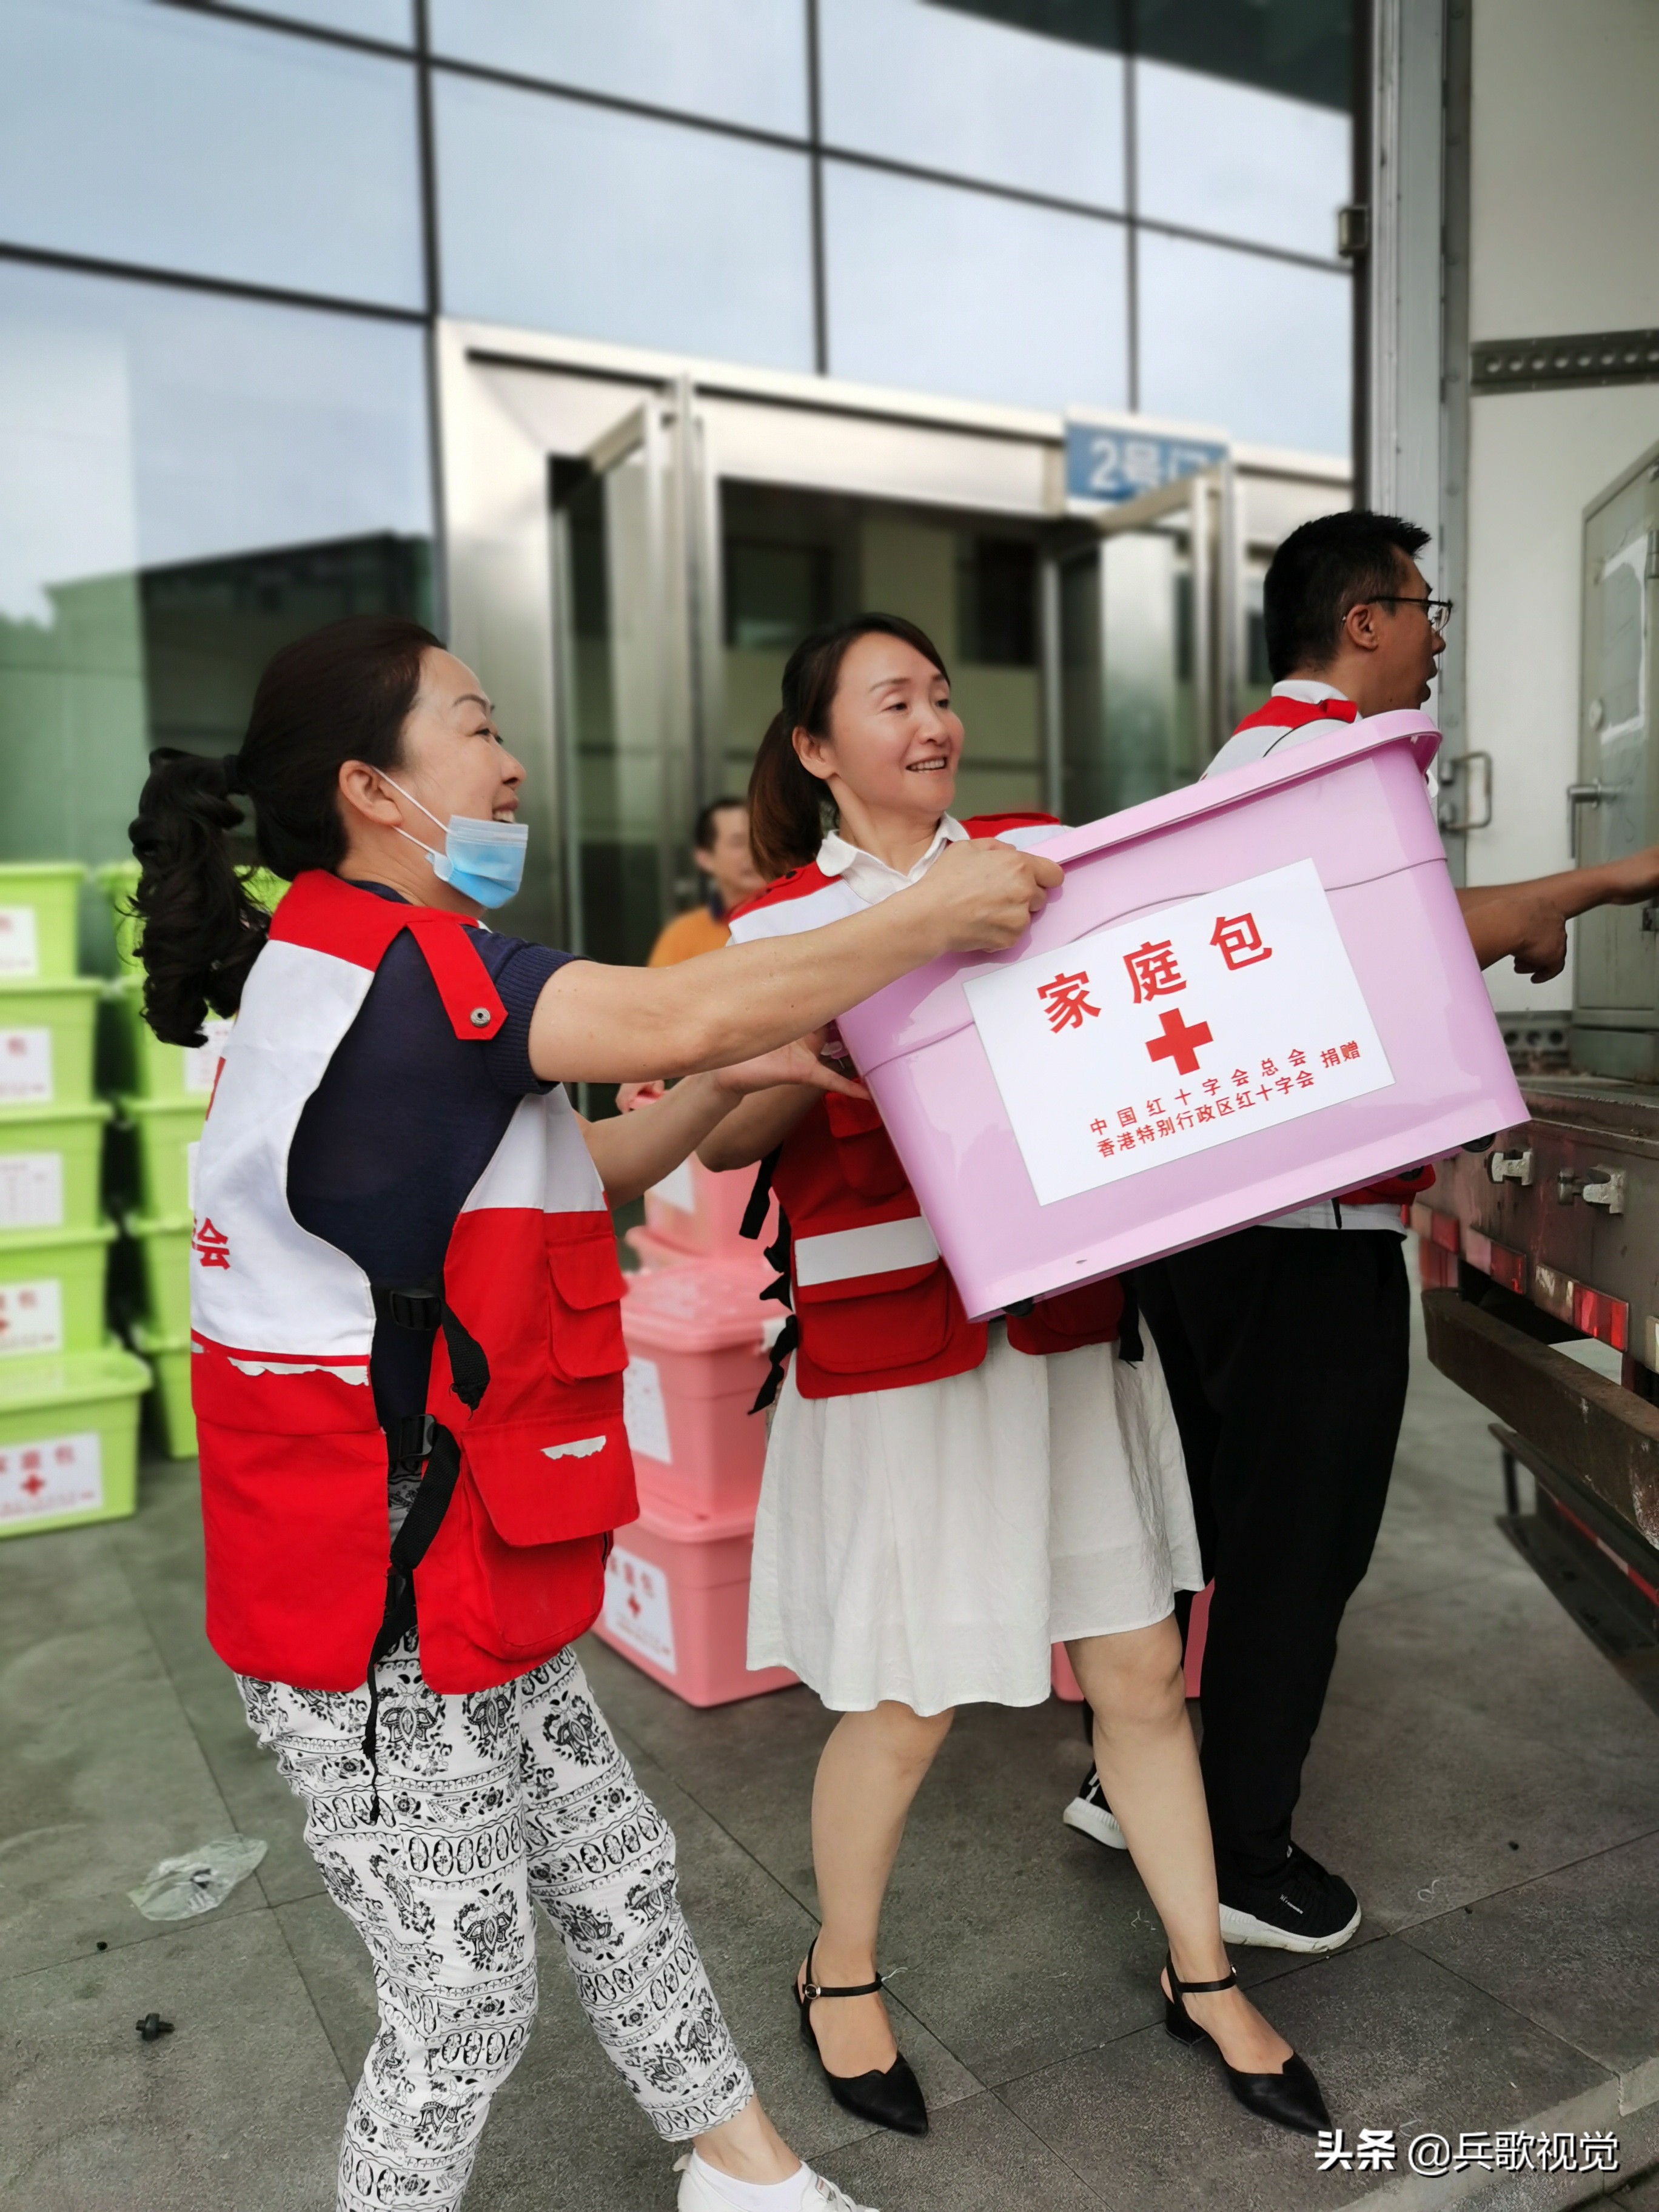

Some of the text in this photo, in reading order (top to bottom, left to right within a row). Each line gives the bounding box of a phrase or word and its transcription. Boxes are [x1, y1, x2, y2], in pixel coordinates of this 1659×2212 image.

[1037, 913, 1273, 1034] 家庭包
[1089, 1048, 1306, 1136] 中国红十字会总会
[1320, 1040, 1361, 1068] 捐赠
[1096, 1070, 1315, 1158] 香港特别行政区红十字会
[192, 1217, 230, 1270] 会
